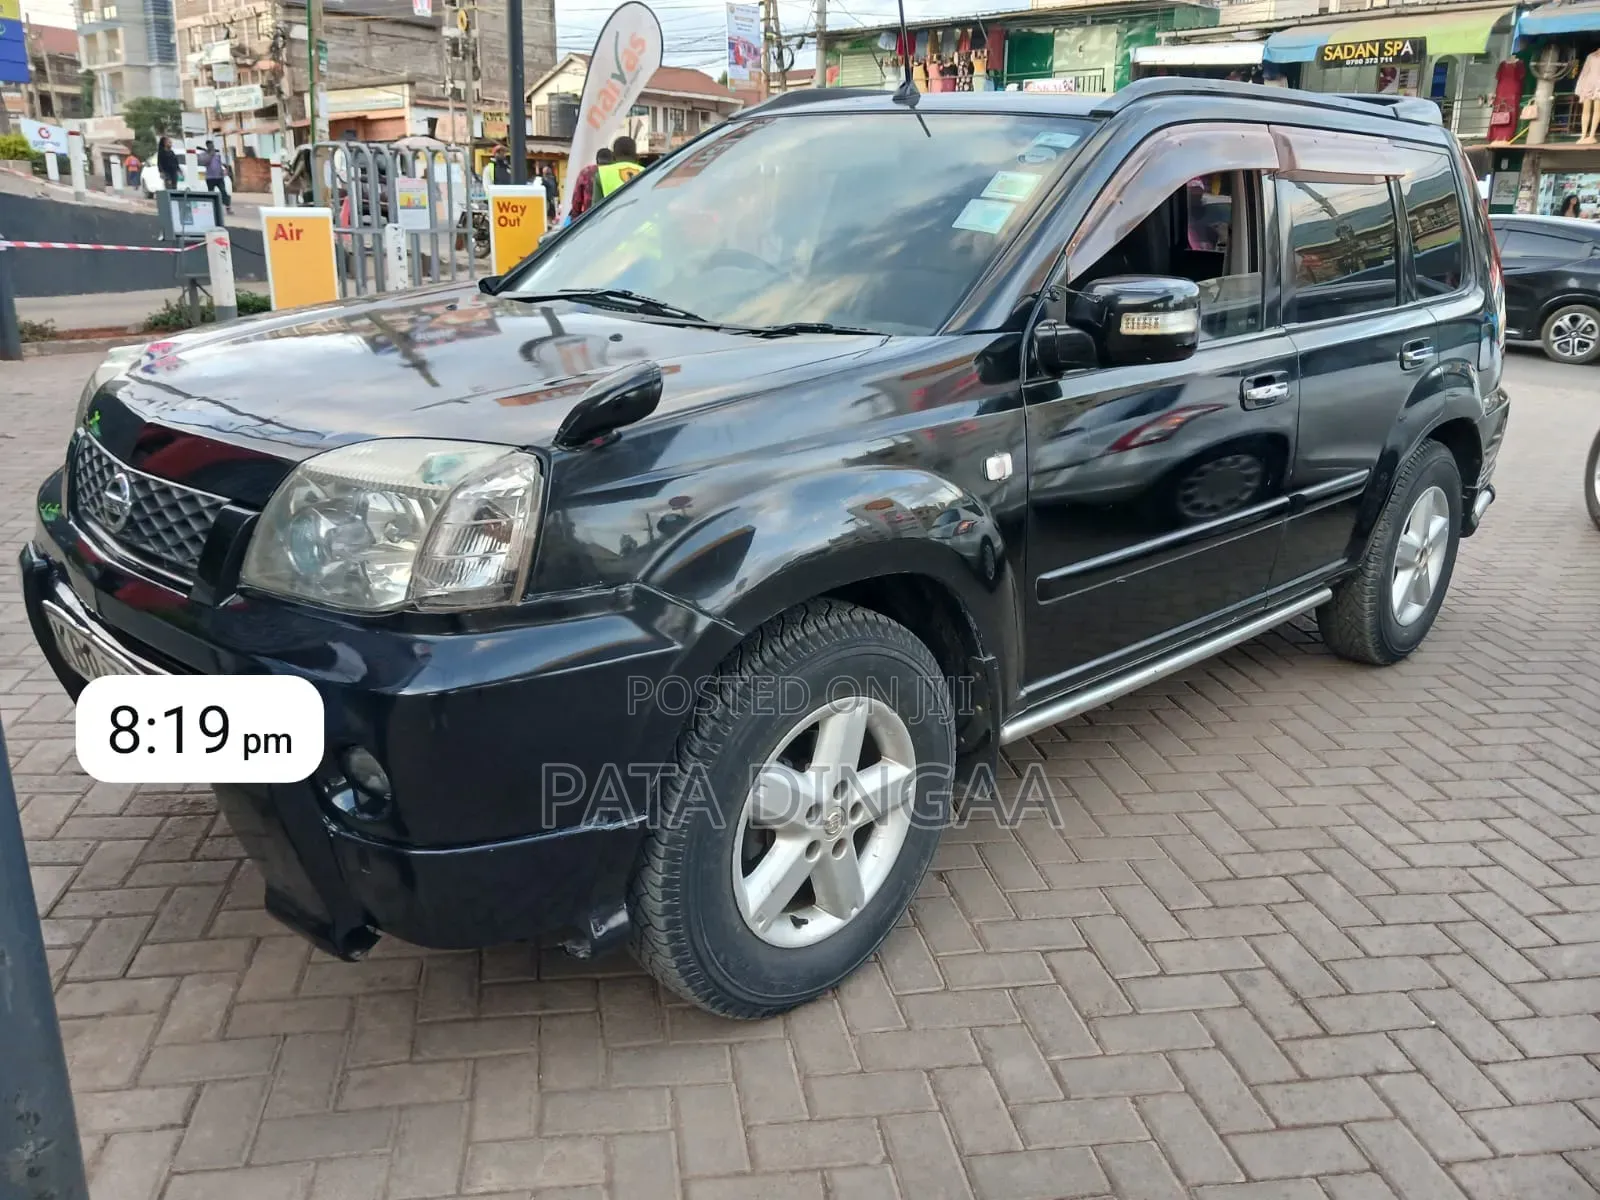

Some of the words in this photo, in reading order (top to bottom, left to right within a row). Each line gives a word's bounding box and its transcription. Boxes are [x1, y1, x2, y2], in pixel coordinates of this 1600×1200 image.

[1323, 42, 1380, 61] SADAN
[1383, 40, 1414, 57] SPA
[496, 201, 528, 217] Way
[497, 215, 521, 228] Out
[273, 221, 305, 241] Air
